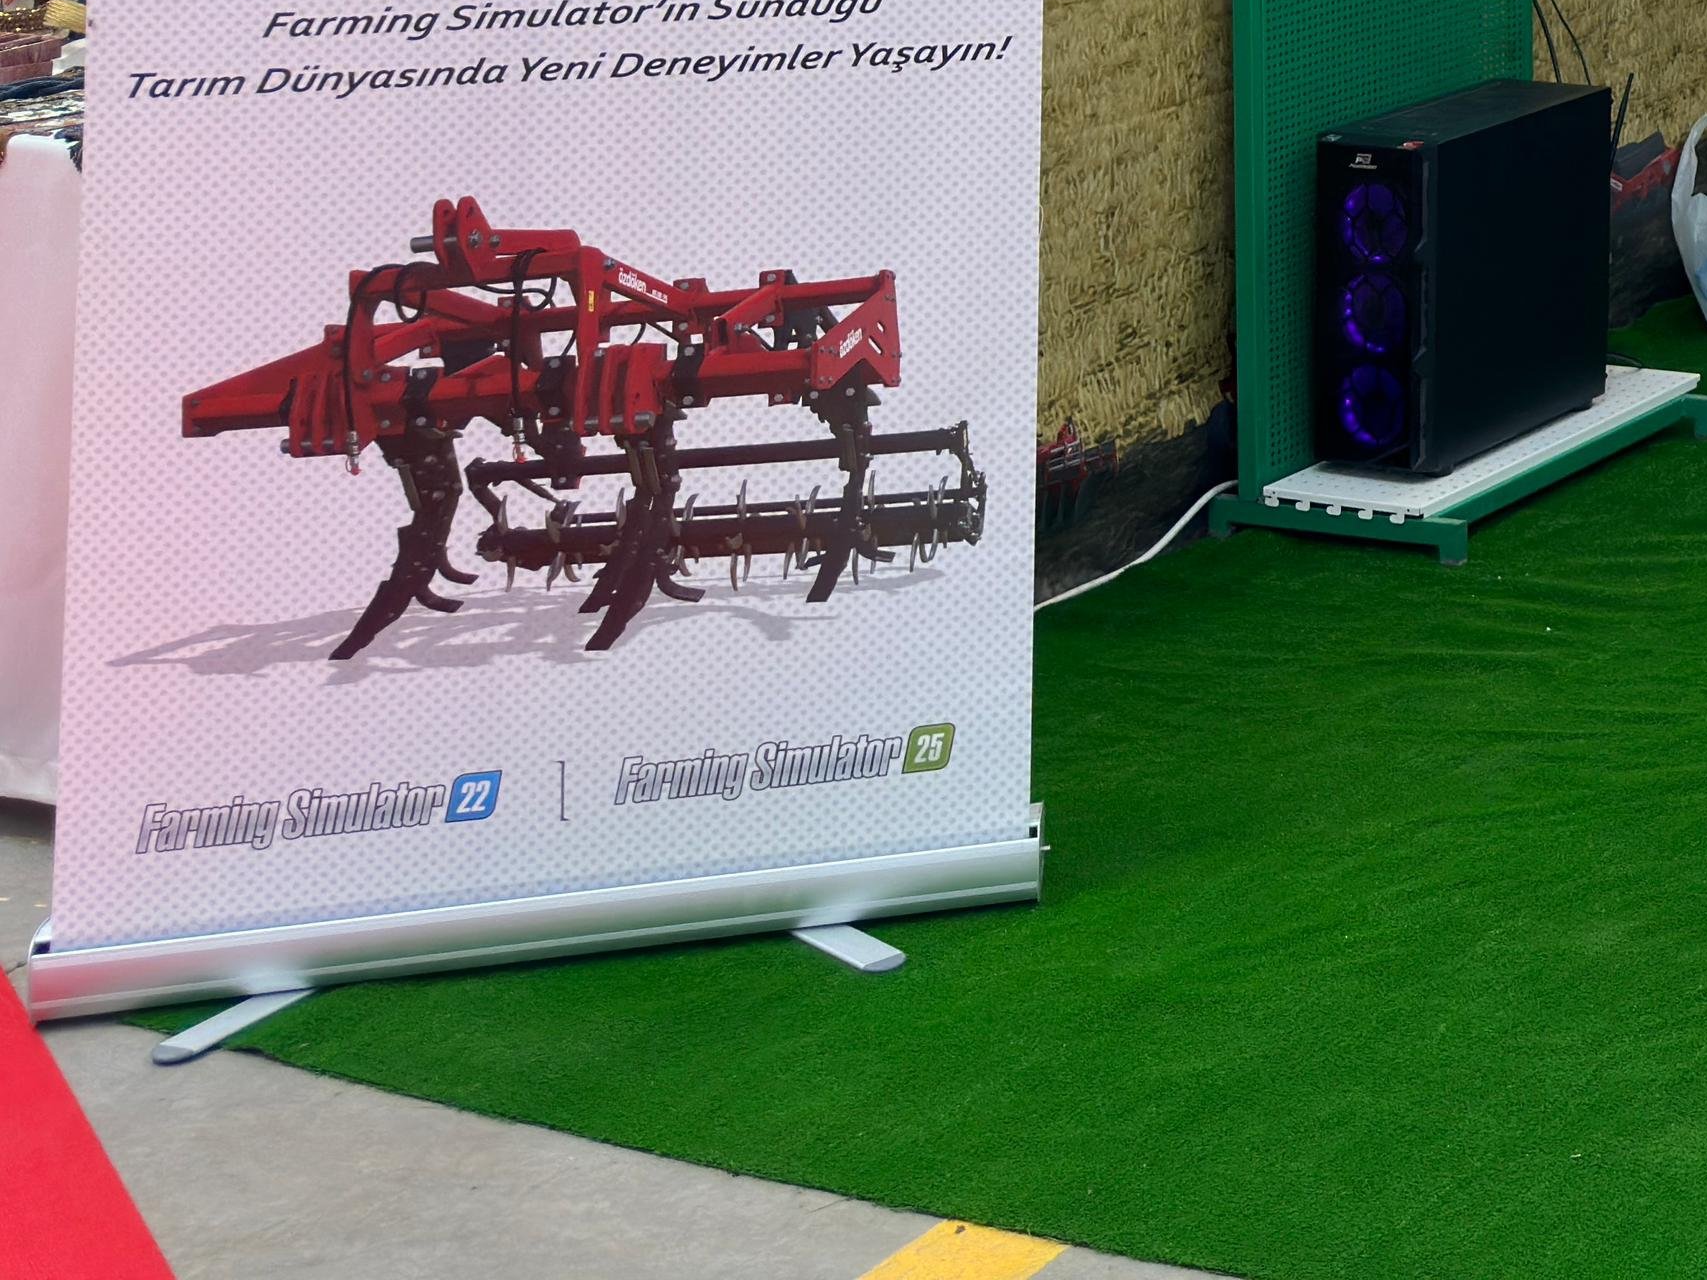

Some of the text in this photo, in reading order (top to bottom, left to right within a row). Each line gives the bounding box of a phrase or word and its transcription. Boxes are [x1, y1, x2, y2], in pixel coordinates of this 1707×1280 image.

[262, 6, 440, 40] Farming
[127, 35, 1013, 99] Tarım Dünyasında Yeni Deneyimler Yaşayın!
[614, 732, 944, 805] Farming Simulator 25
[135, 780, 491, 854] Farming Simulator 22
